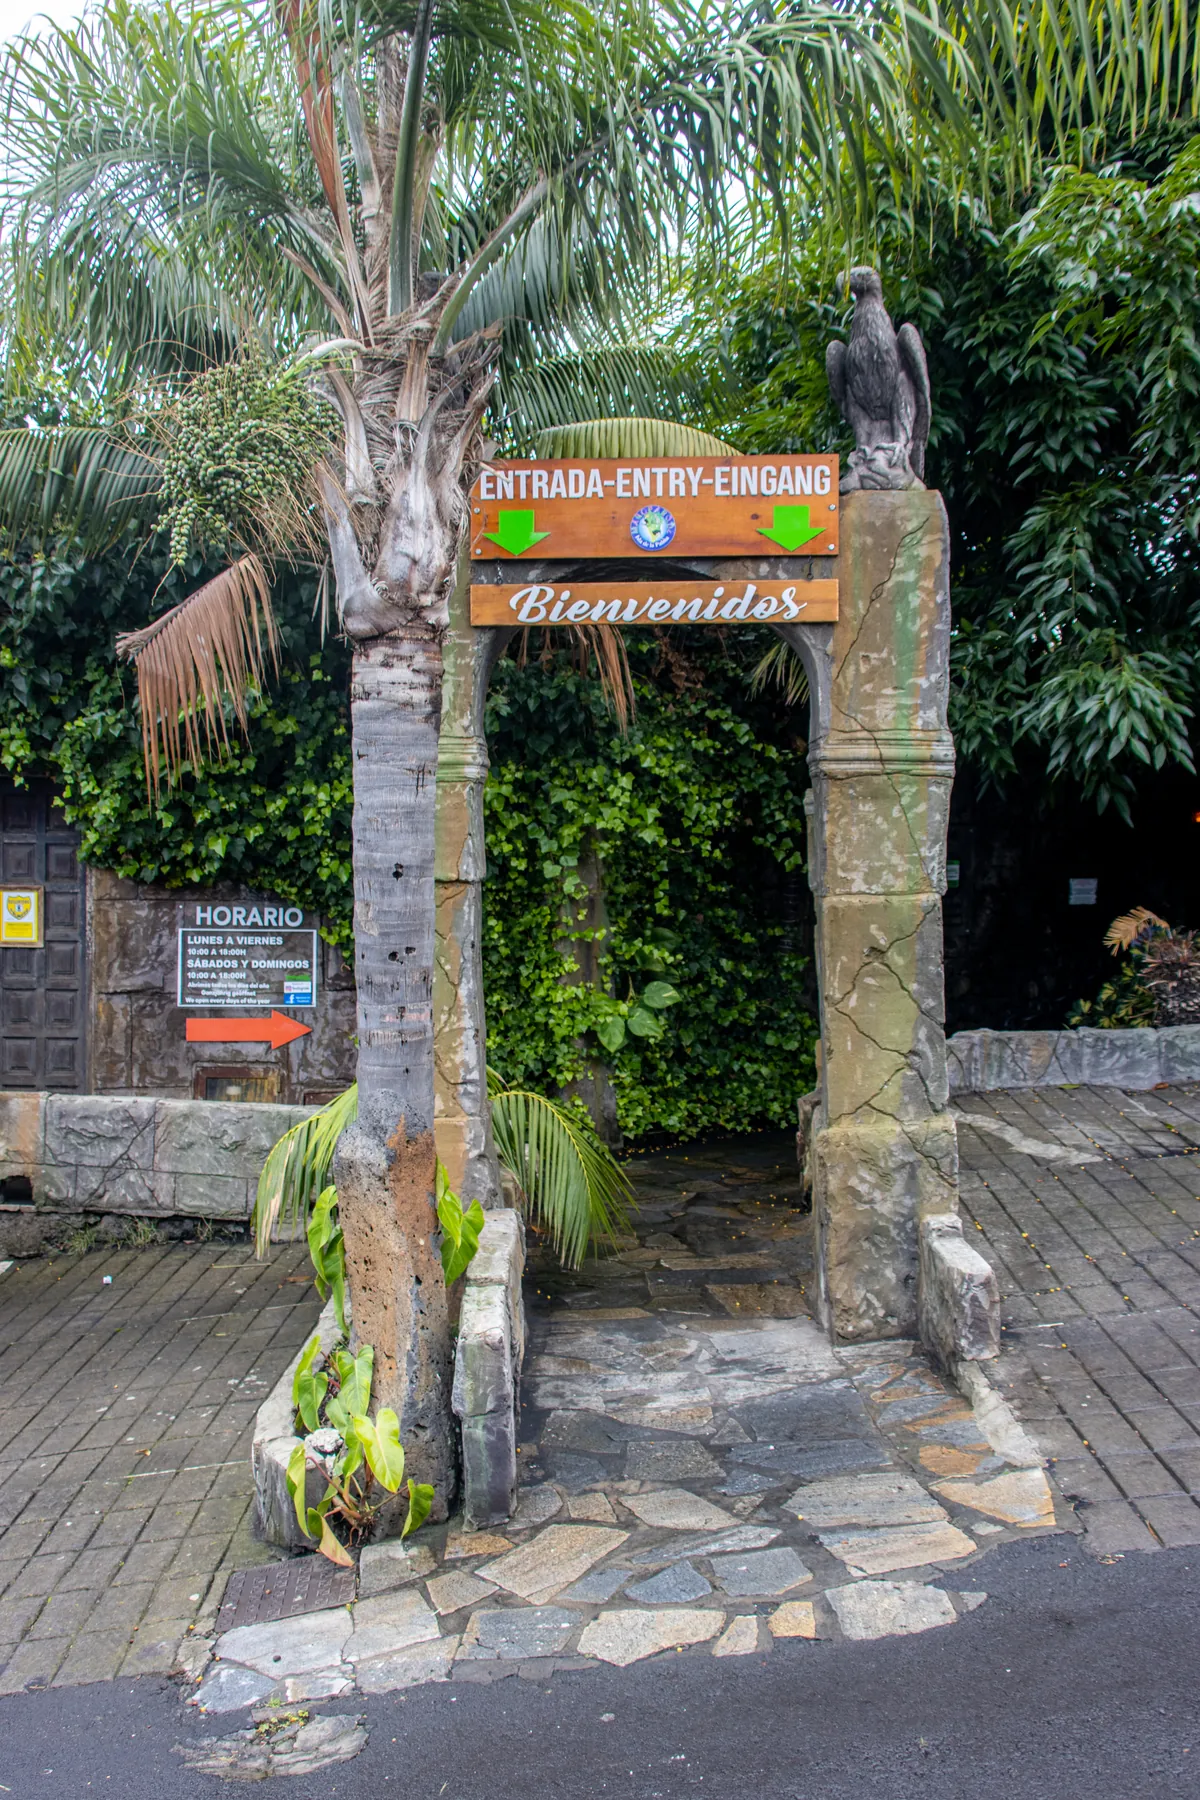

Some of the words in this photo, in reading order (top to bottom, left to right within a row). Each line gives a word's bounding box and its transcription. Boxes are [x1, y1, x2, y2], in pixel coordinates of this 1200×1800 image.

[509, 584, 807, 623] Bienvenidos
[196, 906, 303, 927] HORARIO
[187, 936, 223, 945] LUNES
[226, 936, 235, 945] A
[236, 936, 284, 946] VIERNES
[187, 948, 209, 956] 10:00
[210, 948, 218, 956] A
[219, 948, 247, 956] 18:00H
[187, 957, 239, 969] SÁBADOS
[241, 960, 249, 969] Y
[251, 960, 310, 969] DOMINGOS
[210, 972, 218, 980] A
[219, 972, 247, 980] 18:00H
